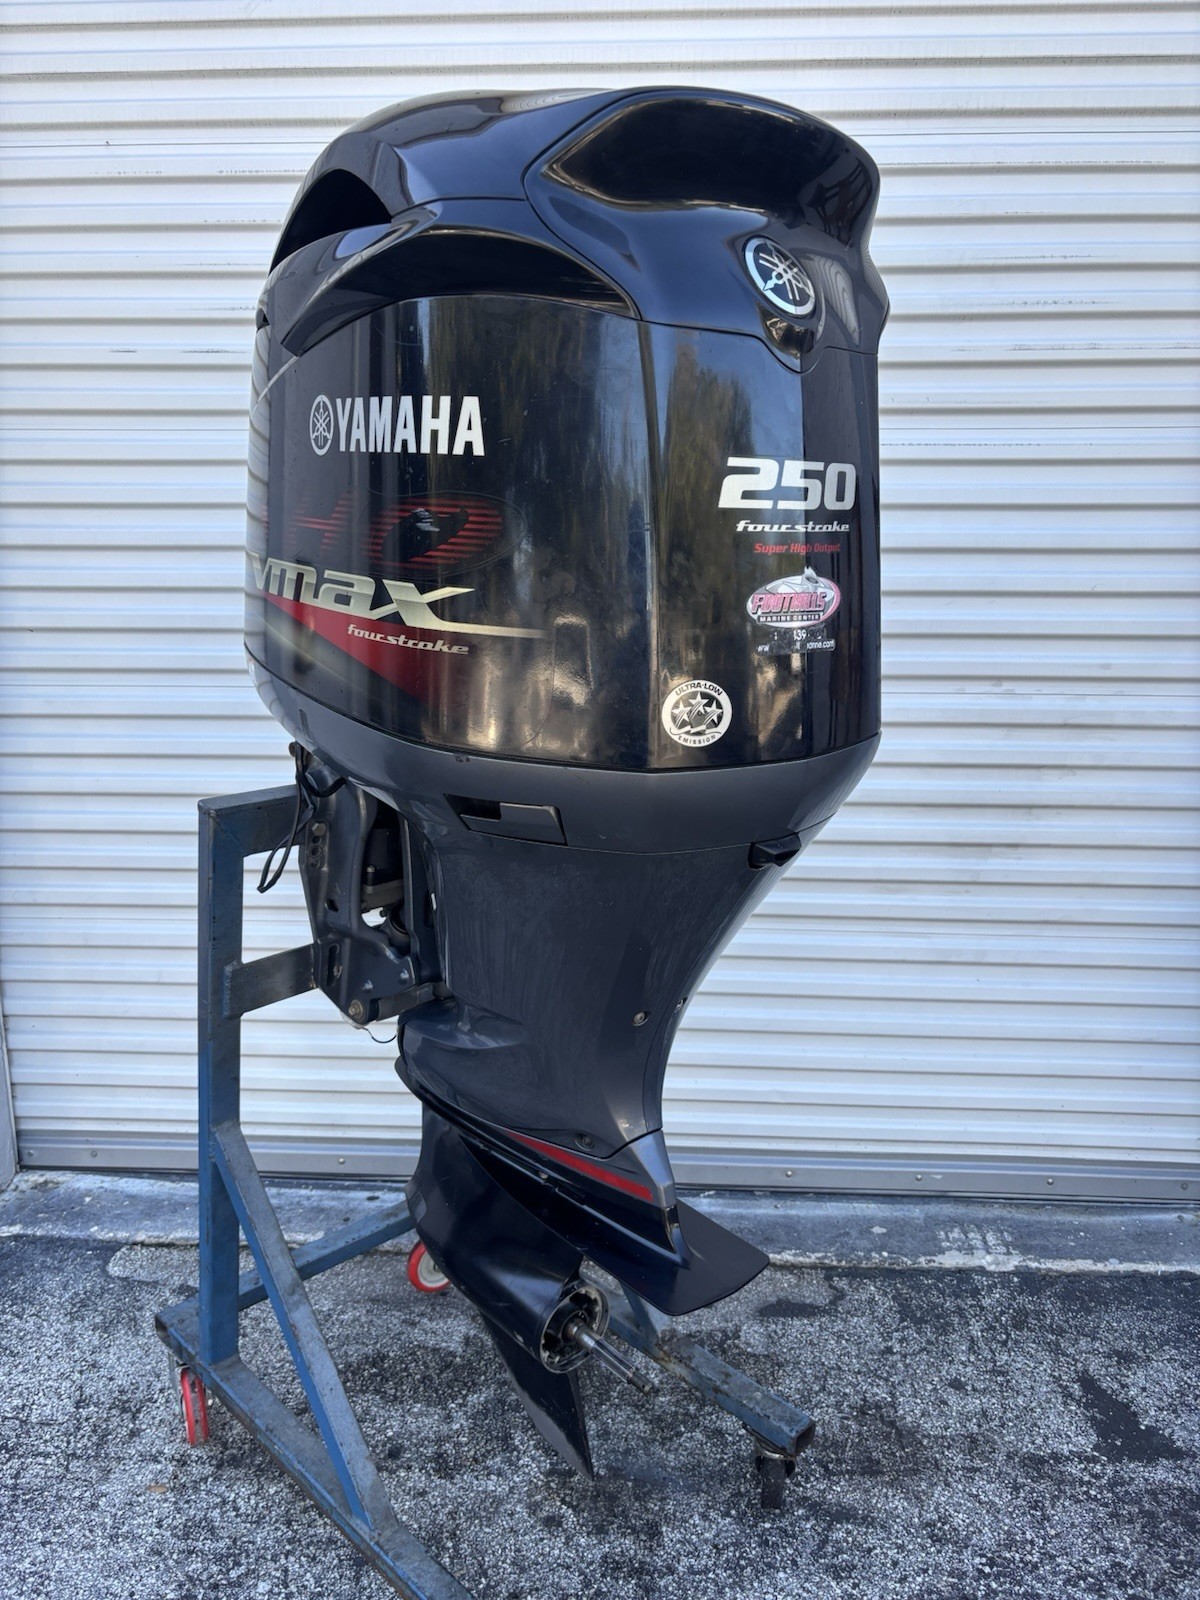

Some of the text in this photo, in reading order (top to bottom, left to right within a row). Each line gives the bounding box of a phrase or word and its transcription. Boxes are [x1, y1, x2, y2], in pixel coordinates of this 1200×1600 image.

[336, 395, 485, 456] YAMAHA
[718, 457, 856, 511] 250
[754, 543, 841, 555] Super High Output
[752, 592, 827, 613] FOOTHILLS
[675, 682, 723, 697] ULTRA-LOW
[678, 735, 716, 745] EMISSION
